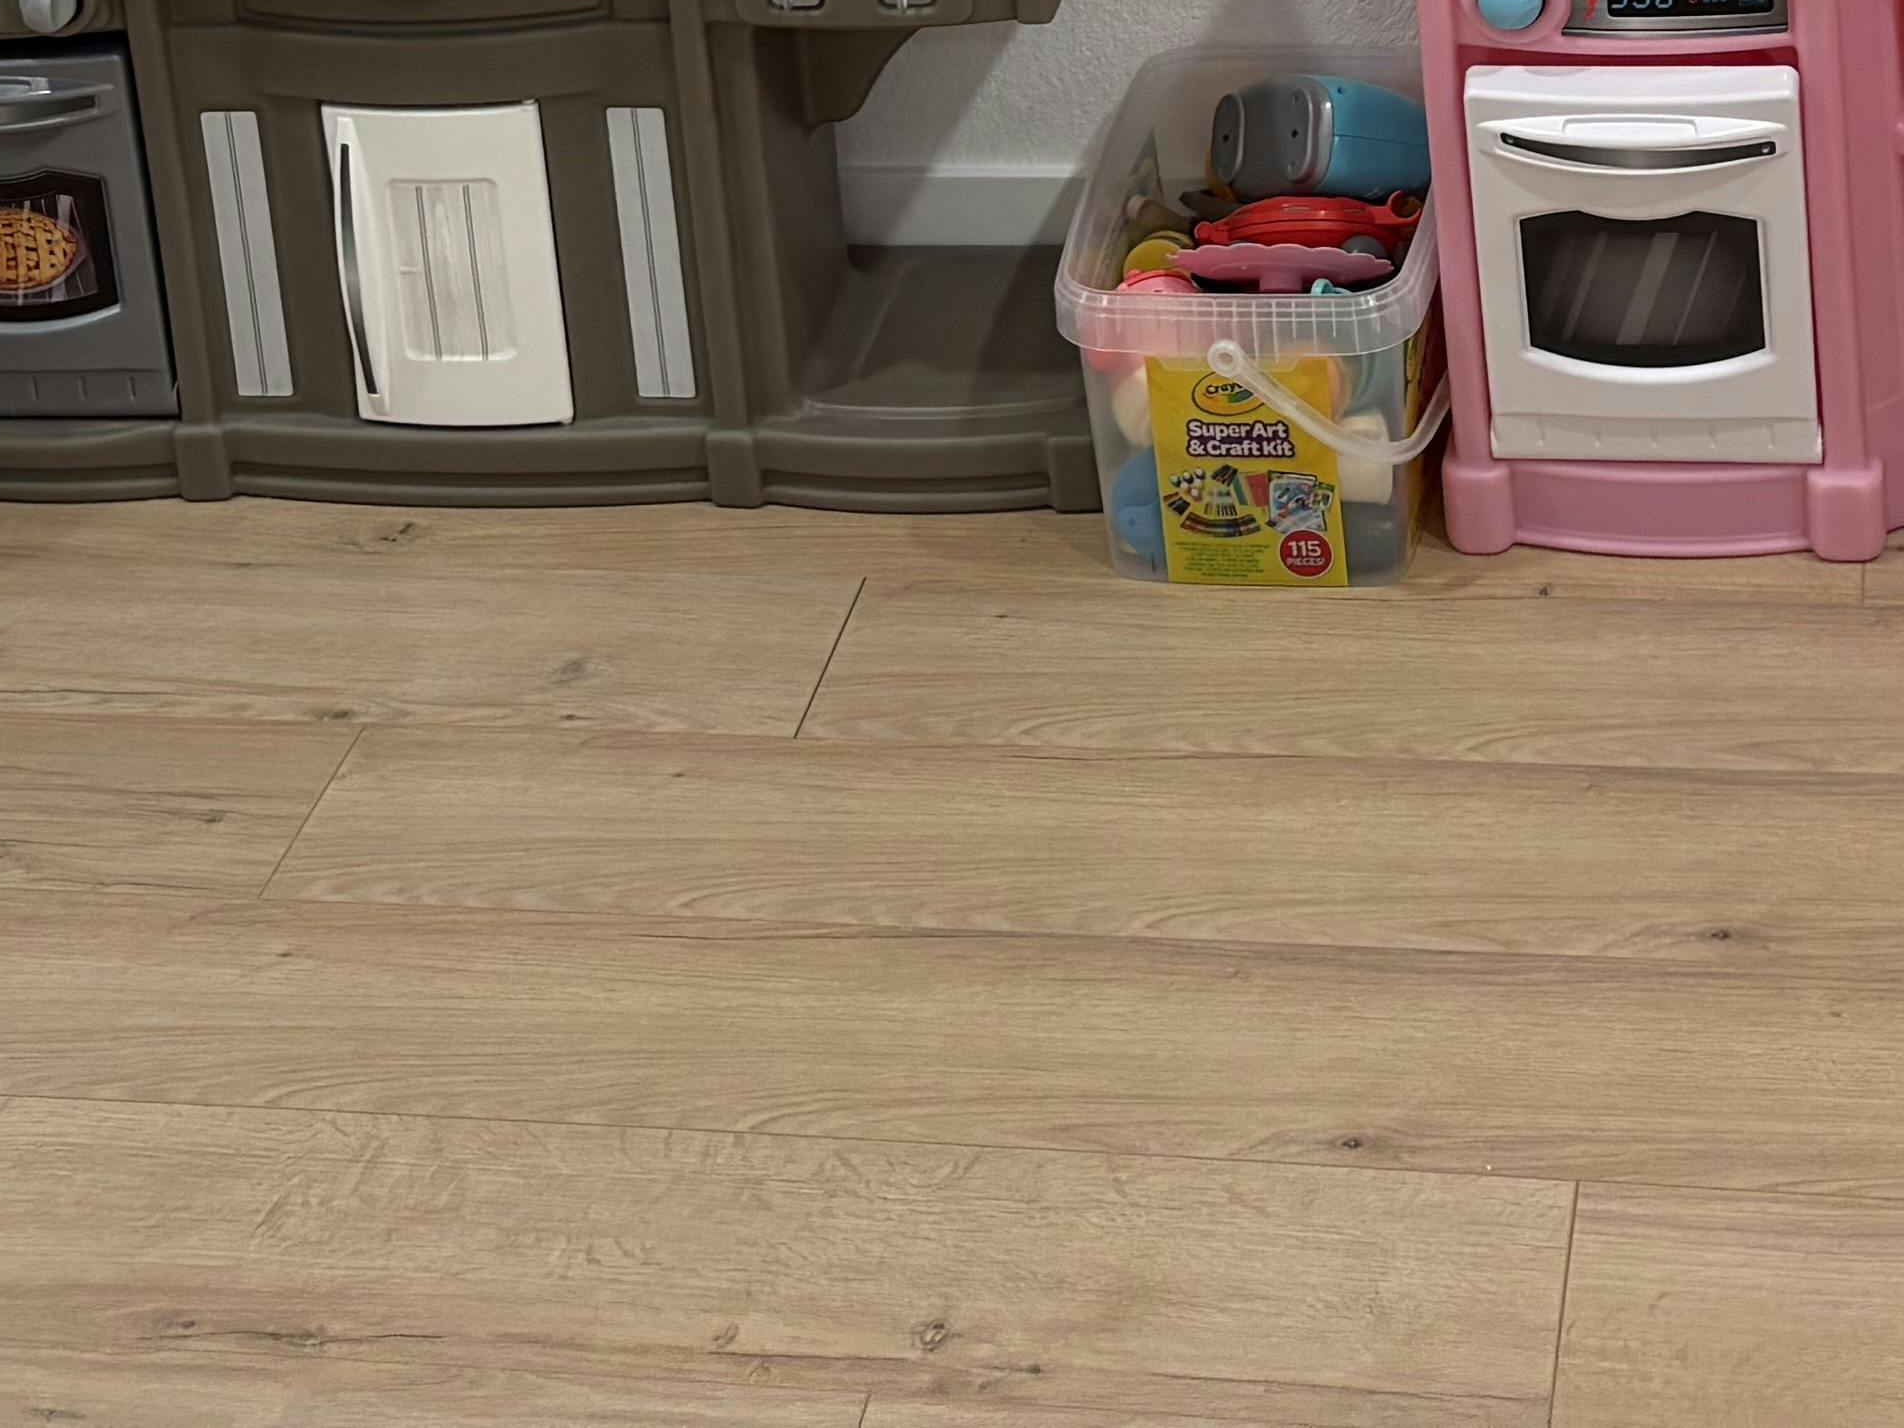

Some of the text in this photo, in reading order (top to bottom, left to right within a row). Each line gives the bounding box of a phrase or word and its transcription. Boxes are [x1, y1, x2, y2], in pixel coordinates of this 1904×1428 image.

[1188, 420, 1288, 441] Super Art
[1188, 439, 1294, 456] & Craft Kit
[1287, 540, 1322, 557] 115
